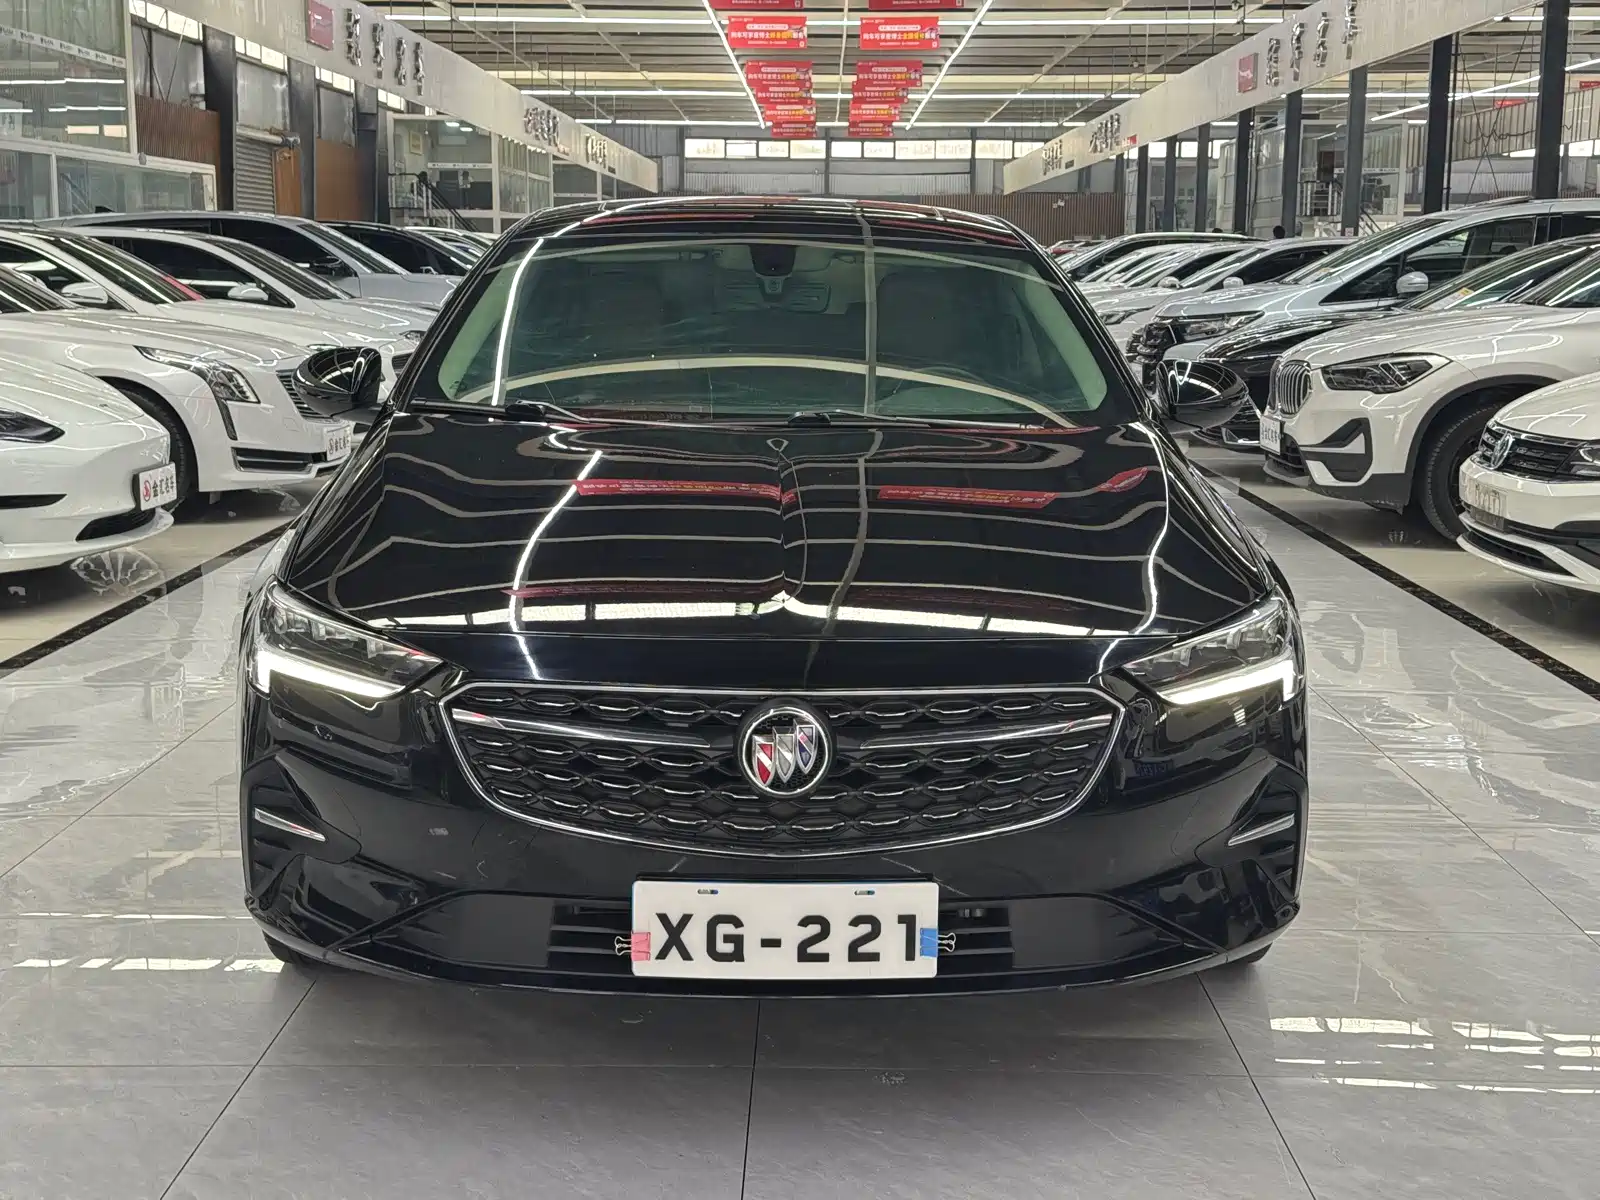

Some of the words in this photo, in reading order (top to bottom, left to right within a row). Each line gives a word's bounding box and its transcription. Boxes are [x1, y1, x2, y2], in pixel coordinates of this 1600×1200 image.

[152, 475, 174, 498] 金汇名车
[655, 912, 917, 963] XG-221
